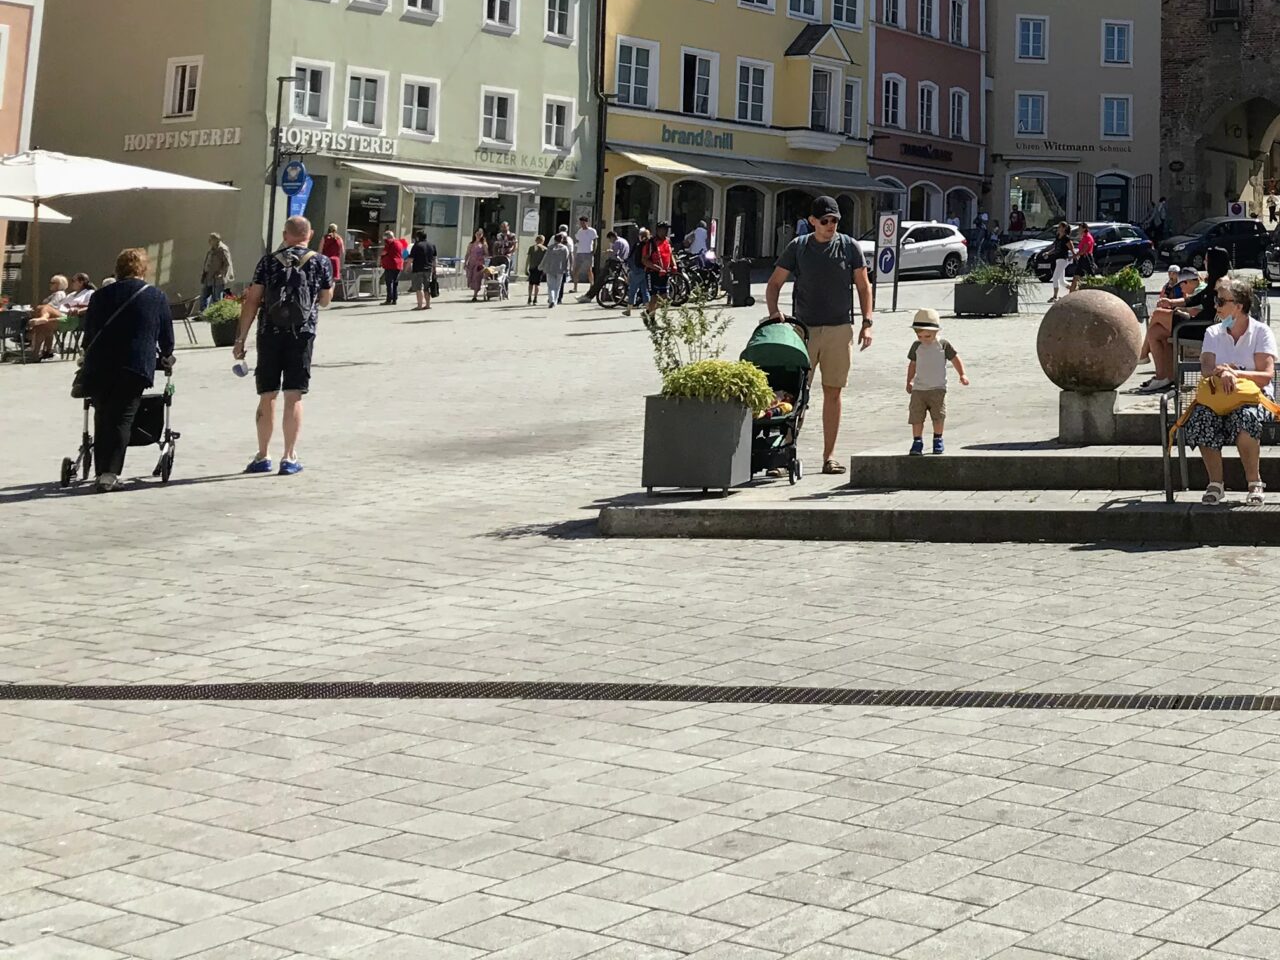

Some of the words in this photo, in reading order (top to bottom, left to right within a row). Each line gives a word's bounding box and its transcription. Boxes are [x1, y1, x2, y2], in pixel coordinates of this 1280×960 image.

[124, 128, 241, 151] HOFPFISTEREI
[279, 126, 399, 156] HOFPFISTEREI
[662, 123, 733, 151] brand&nill
[1015, 142, 1040, 151] Uhren
[1043, 140, 1095, 152] Wittmann
[1098, 144, 1132, 153] Schmuck
[474, 148, 517, 166] TÖLZER
[885, 222, 893, 233] 30
